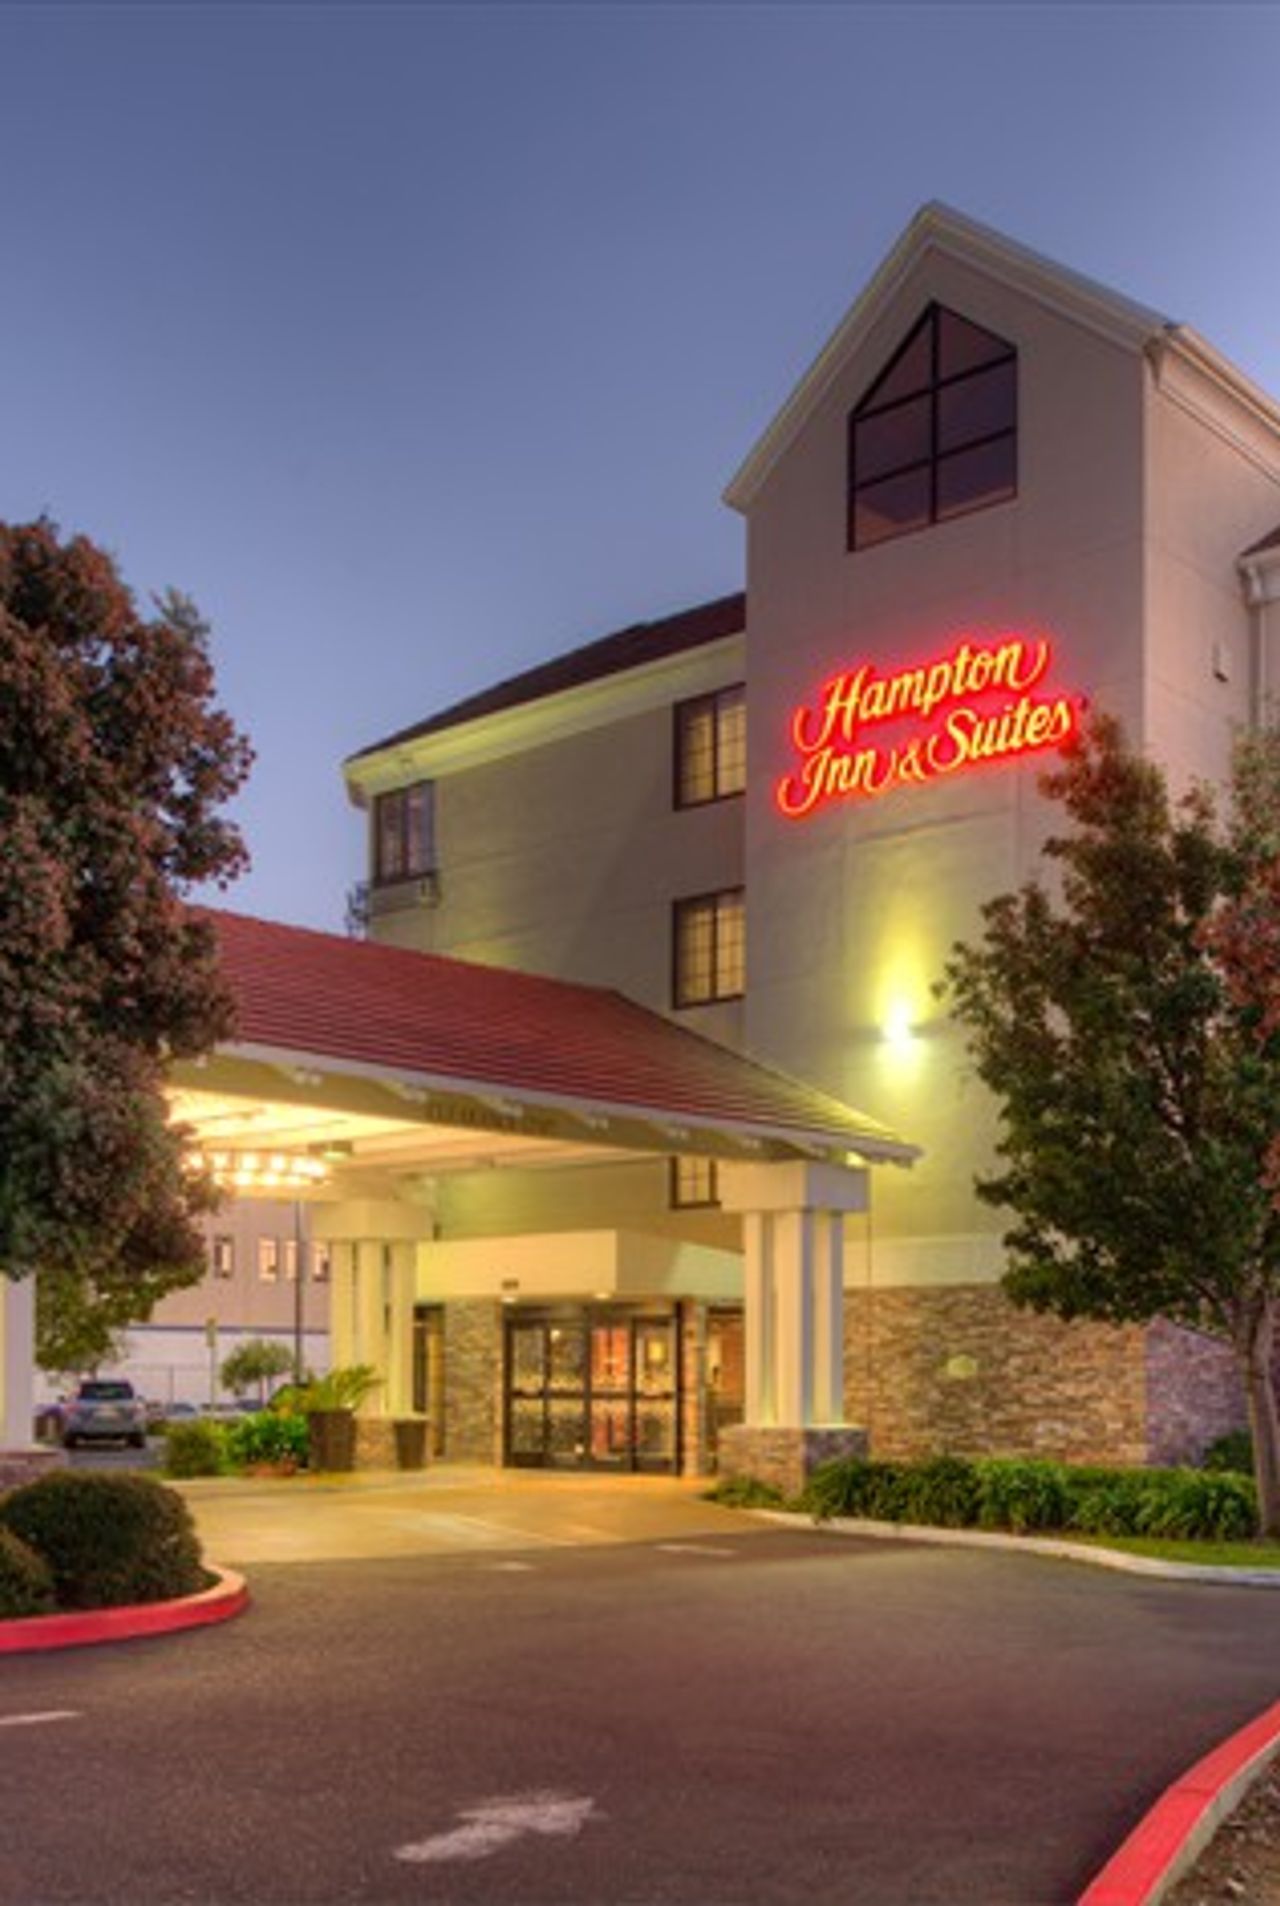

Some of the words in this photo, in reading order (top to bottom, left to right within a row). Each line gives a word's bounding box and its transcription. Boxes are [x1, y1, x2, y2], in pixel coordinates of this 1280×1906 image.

[793, 640, 1047, 751] Hampton
[776, 748, 898, 815] Inn
[899, 743, 927, 782] &
[927, 697, 1072, 773] Suites
